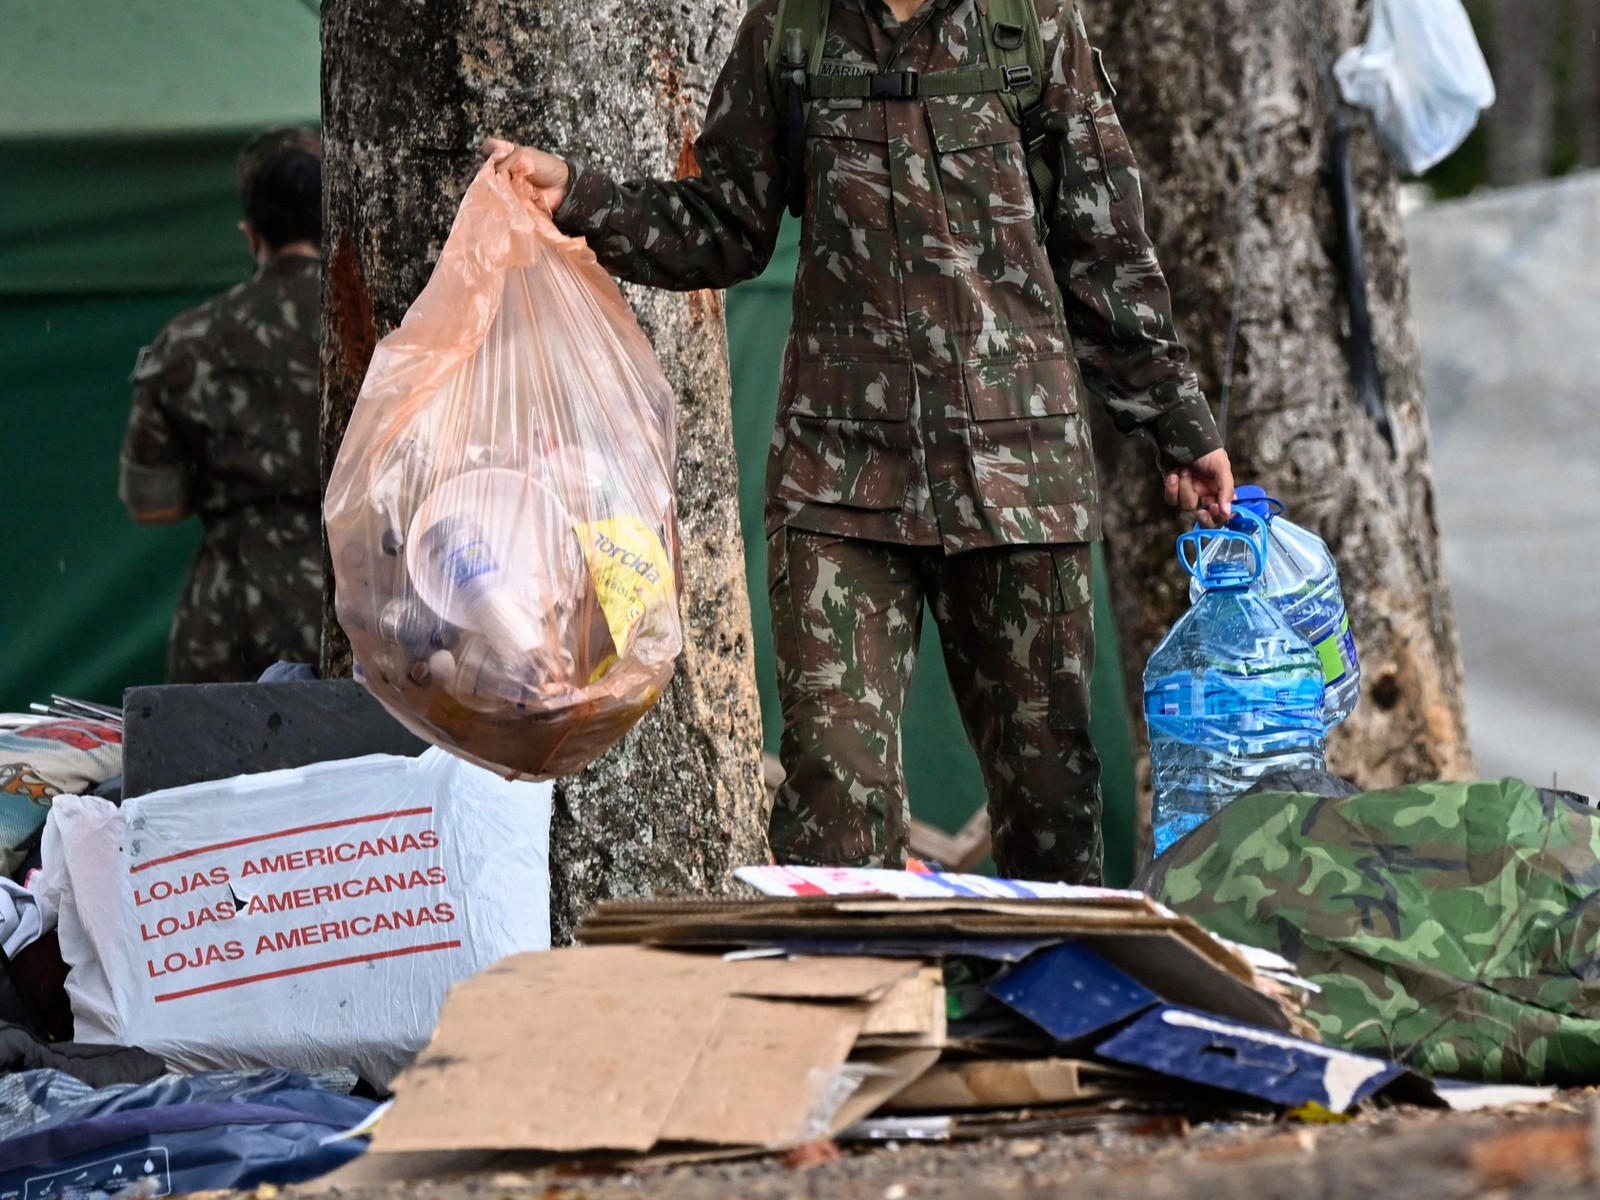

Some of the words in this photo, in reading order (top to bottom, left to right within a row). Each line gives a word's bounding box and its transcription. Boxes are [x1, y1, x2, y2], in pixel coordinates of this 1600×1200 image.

[134, 867, 230, 906] LOJAS
[241, 830, 439, 878] AMERICANAS
[140, 901, 236, 941] LOJAS
[247, 866, 447, 915] AMERICANAS
[147, 940, 245, 978] LOJAS
[255, 902, 455, 955] AMERICANAS
